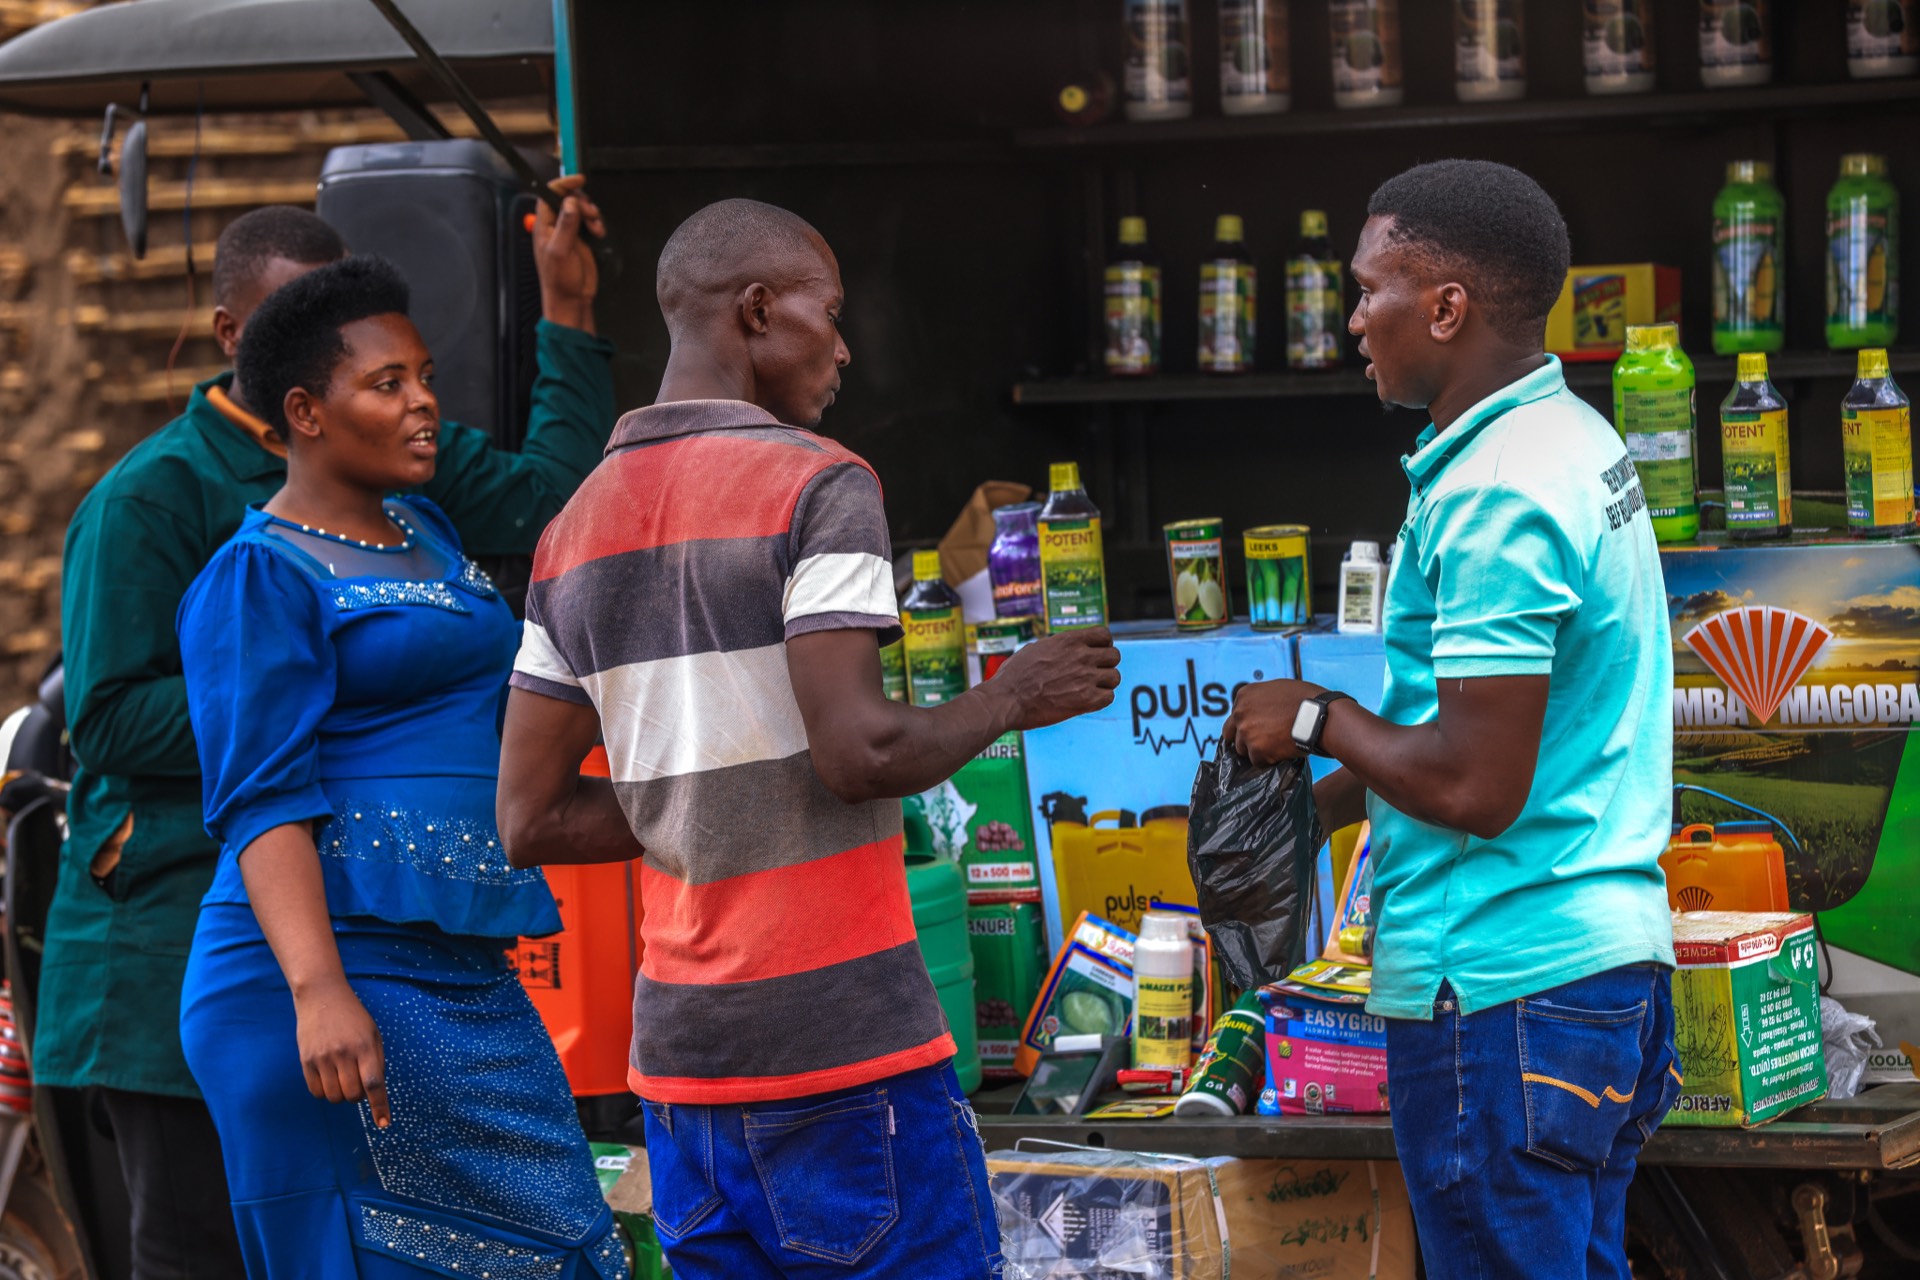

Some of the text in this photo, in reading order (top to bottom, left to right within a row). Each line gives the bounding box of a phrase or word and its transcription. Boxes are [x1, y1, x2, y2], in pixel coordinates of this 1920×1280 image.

[1045, 531, 1094, 547] POTENT
[1250, 542, 1278, 551] LEEKS
[908, 619, 956, 636] POTENT
[990, 867, 1010, 877] 500
[1675, 947, 1717, 958] POWER
[1304, 1009, 1386, 1034] EASYGRO
